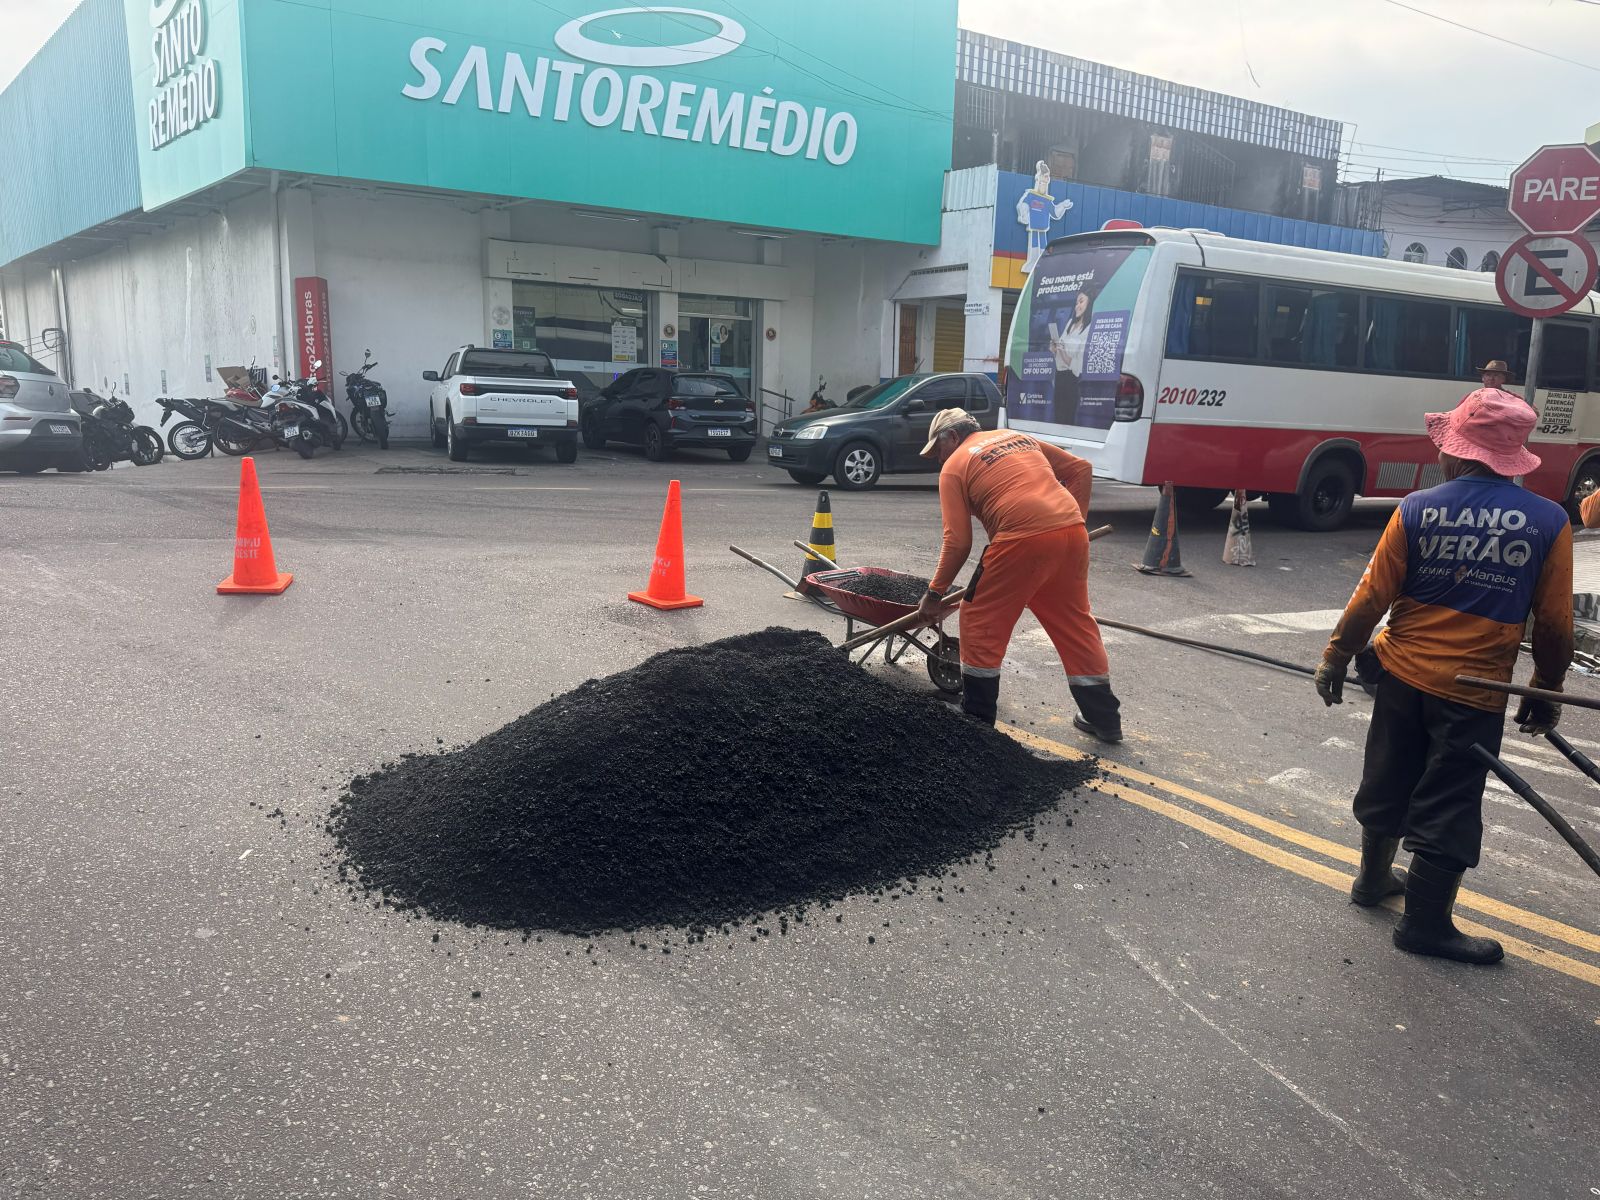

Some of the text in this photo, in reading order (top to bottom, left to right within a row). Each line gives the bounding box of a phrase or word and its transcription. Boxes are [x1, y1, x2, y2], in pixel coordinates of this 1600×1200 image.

[151, 0, 205, 87] SANTO
[149, 58, 219, 151] REMÉDIO
[1522, 176, 1600, 203] PARE
[1040, 270, 1095, 286] Seu nome está
[1524, 249, 1568, 296] E
[1036, 281, 1084, 298] protestado?
[304, 291, 319, 387] co24Horas
[1158, 386, 1226, 406] 2010/232
[1420, 506, 1539, 536] PLANO de
[1418, 528, 1532, 567] VERÃO
[1466, 568, 1517, 586] Manaus
